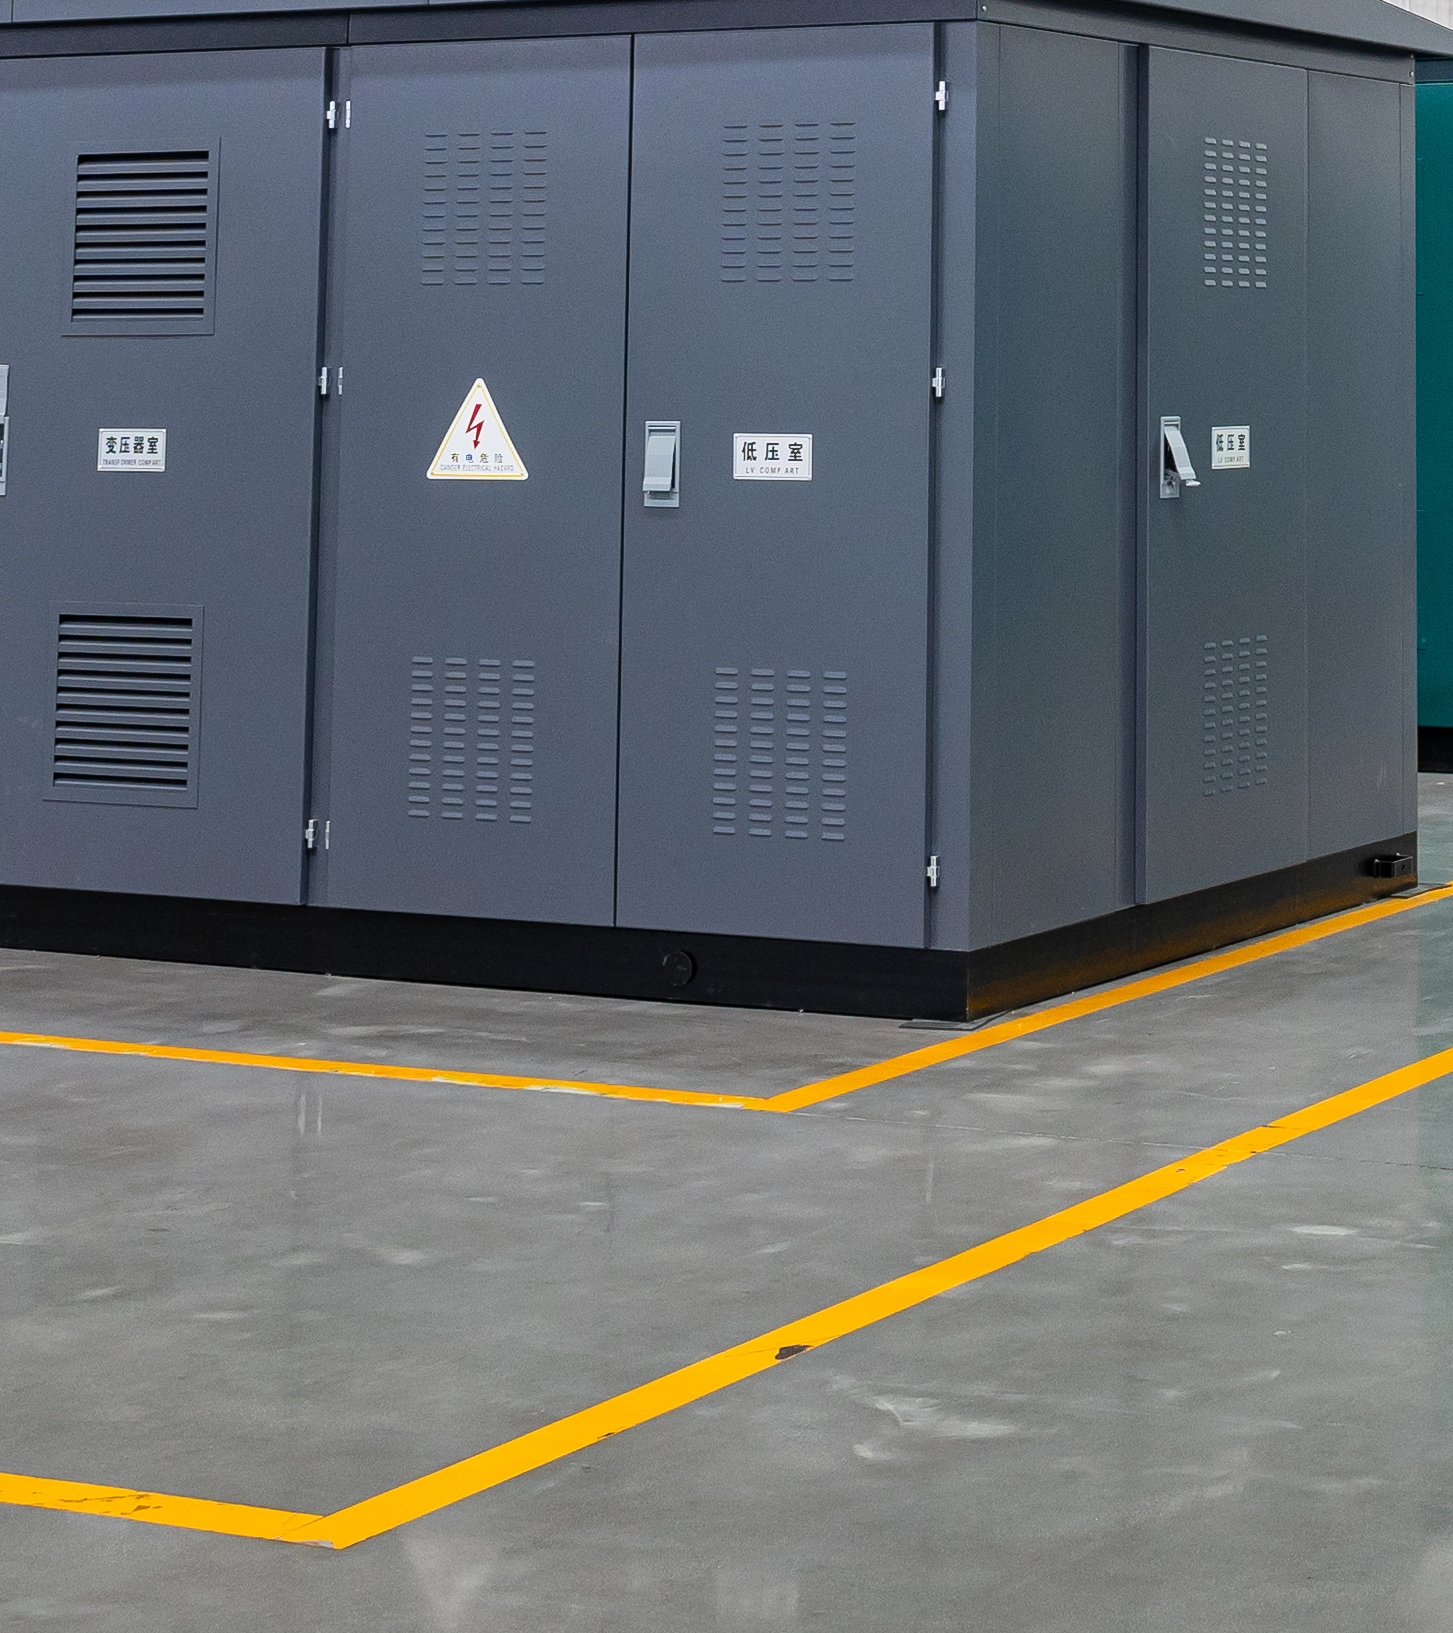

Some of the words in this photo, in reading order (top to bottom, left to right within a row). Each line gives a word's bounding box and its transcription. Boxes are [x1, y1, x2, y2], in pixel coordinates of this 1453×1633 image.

[105, 436, 159, 454] 变压器室
[741, 441, 804, 462] 低压室
[451, 453, 504, 463] 有电危险
